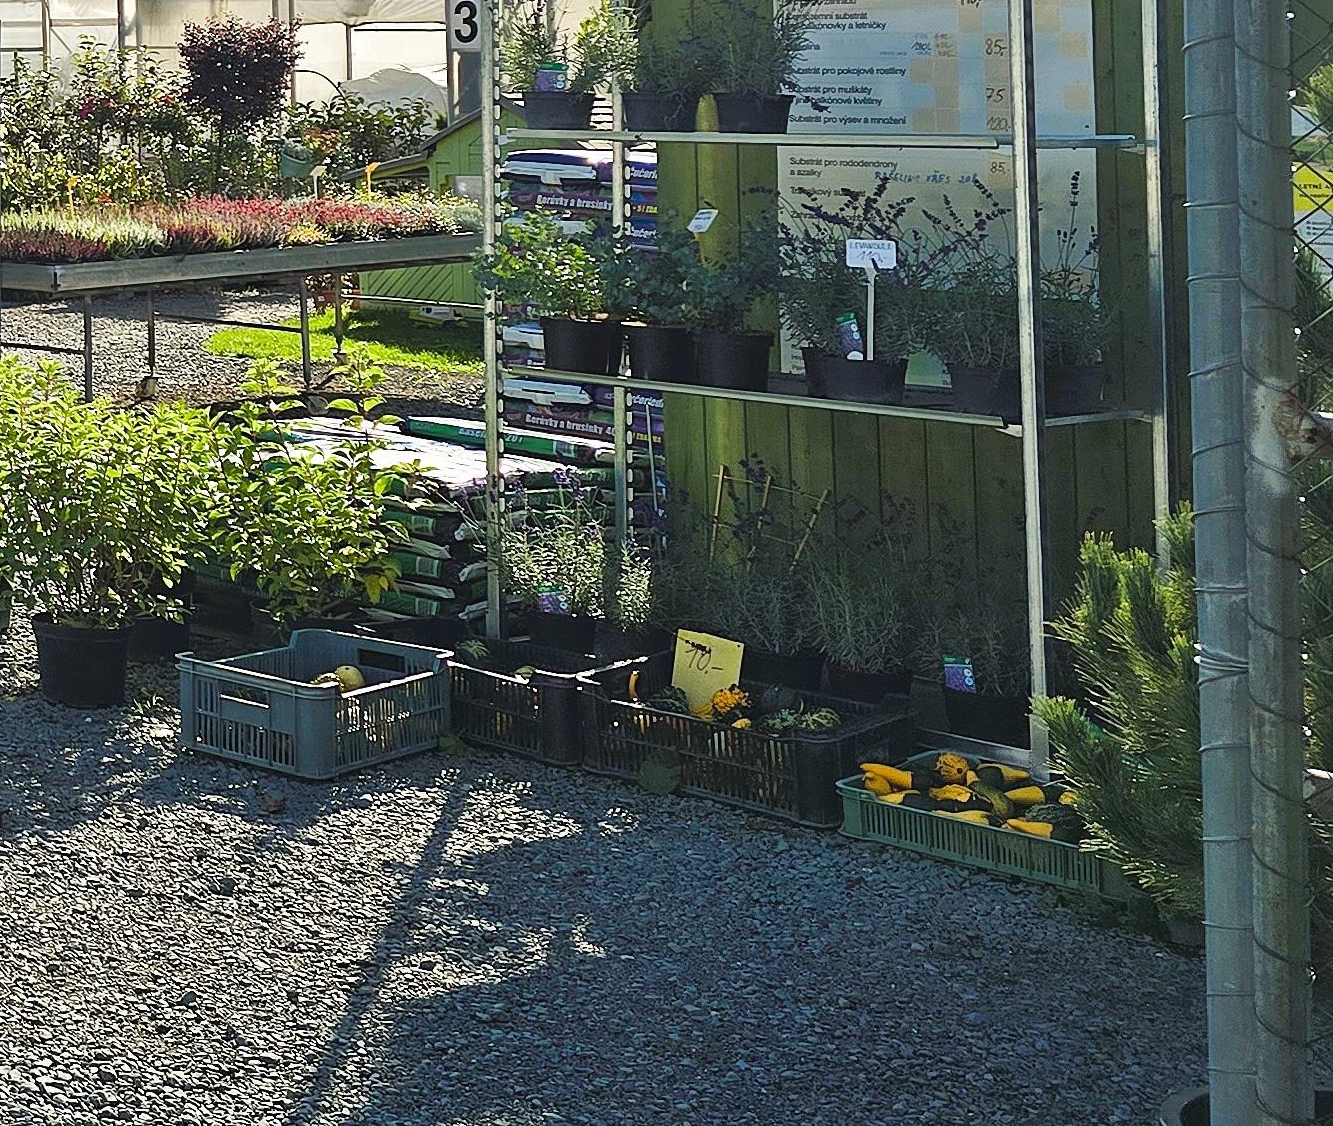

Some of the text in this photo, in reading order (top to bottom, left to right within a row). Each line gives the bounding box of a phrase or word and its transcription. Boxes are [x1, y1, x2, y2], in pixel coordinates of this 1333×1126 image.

[453, 0, 479, 43] 3
[822, 68, 836, 76] pro
[822, 87, 836, 95] pro
[823, 117, 837, 125] pro
[824, 158, 838, 167] pro
